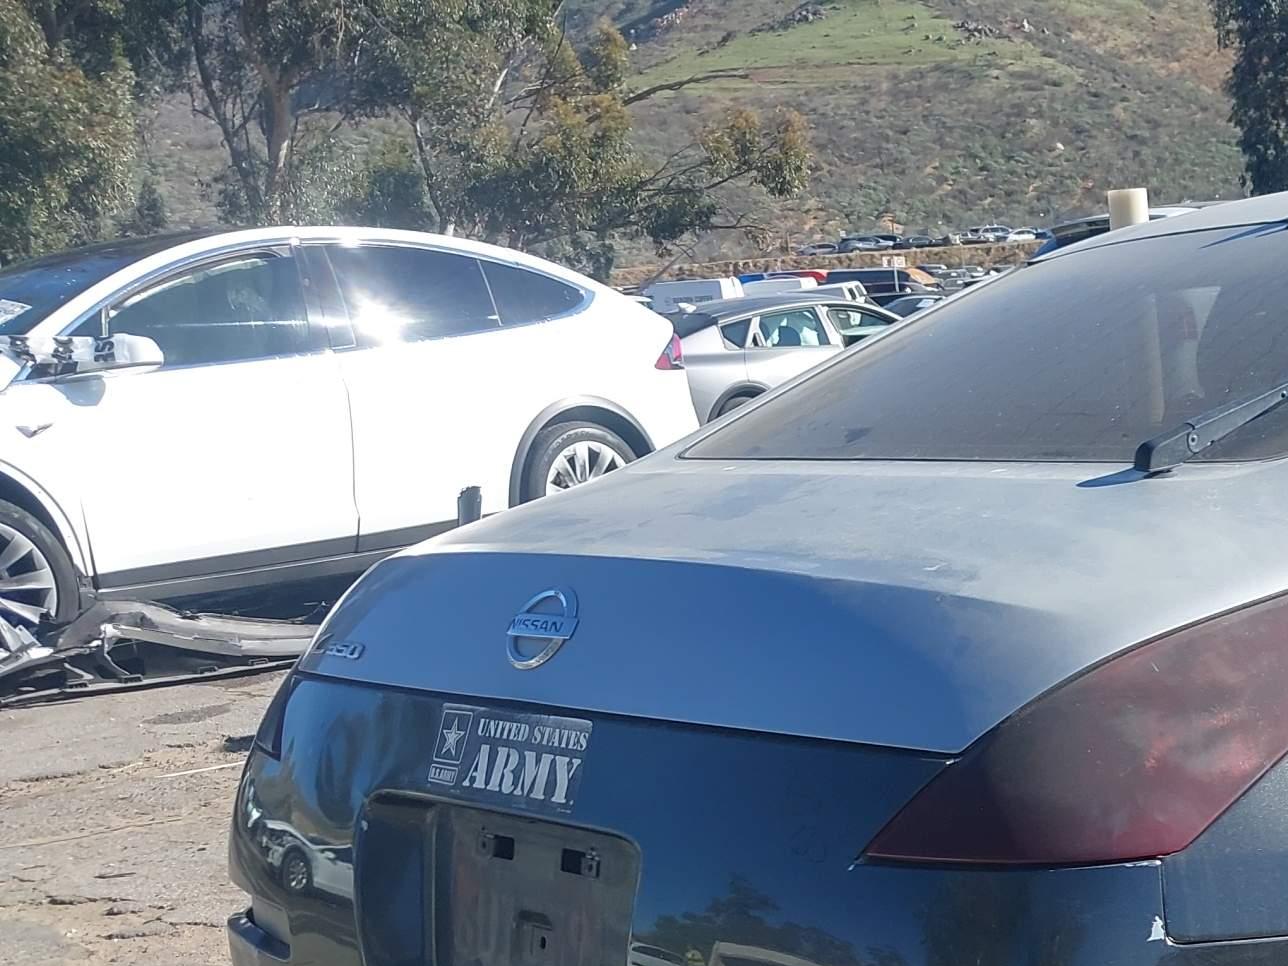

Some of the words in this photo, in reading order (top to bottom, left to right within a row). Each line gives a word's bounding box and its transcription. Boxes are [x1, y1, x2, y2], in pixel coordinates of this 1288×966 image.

[511, 617, 564, 633] NISSAN
[478, 718, 529, 742] UNITED
[531, 725, 589, 751] STATES
[462, 744, 582, 803] ARMY
